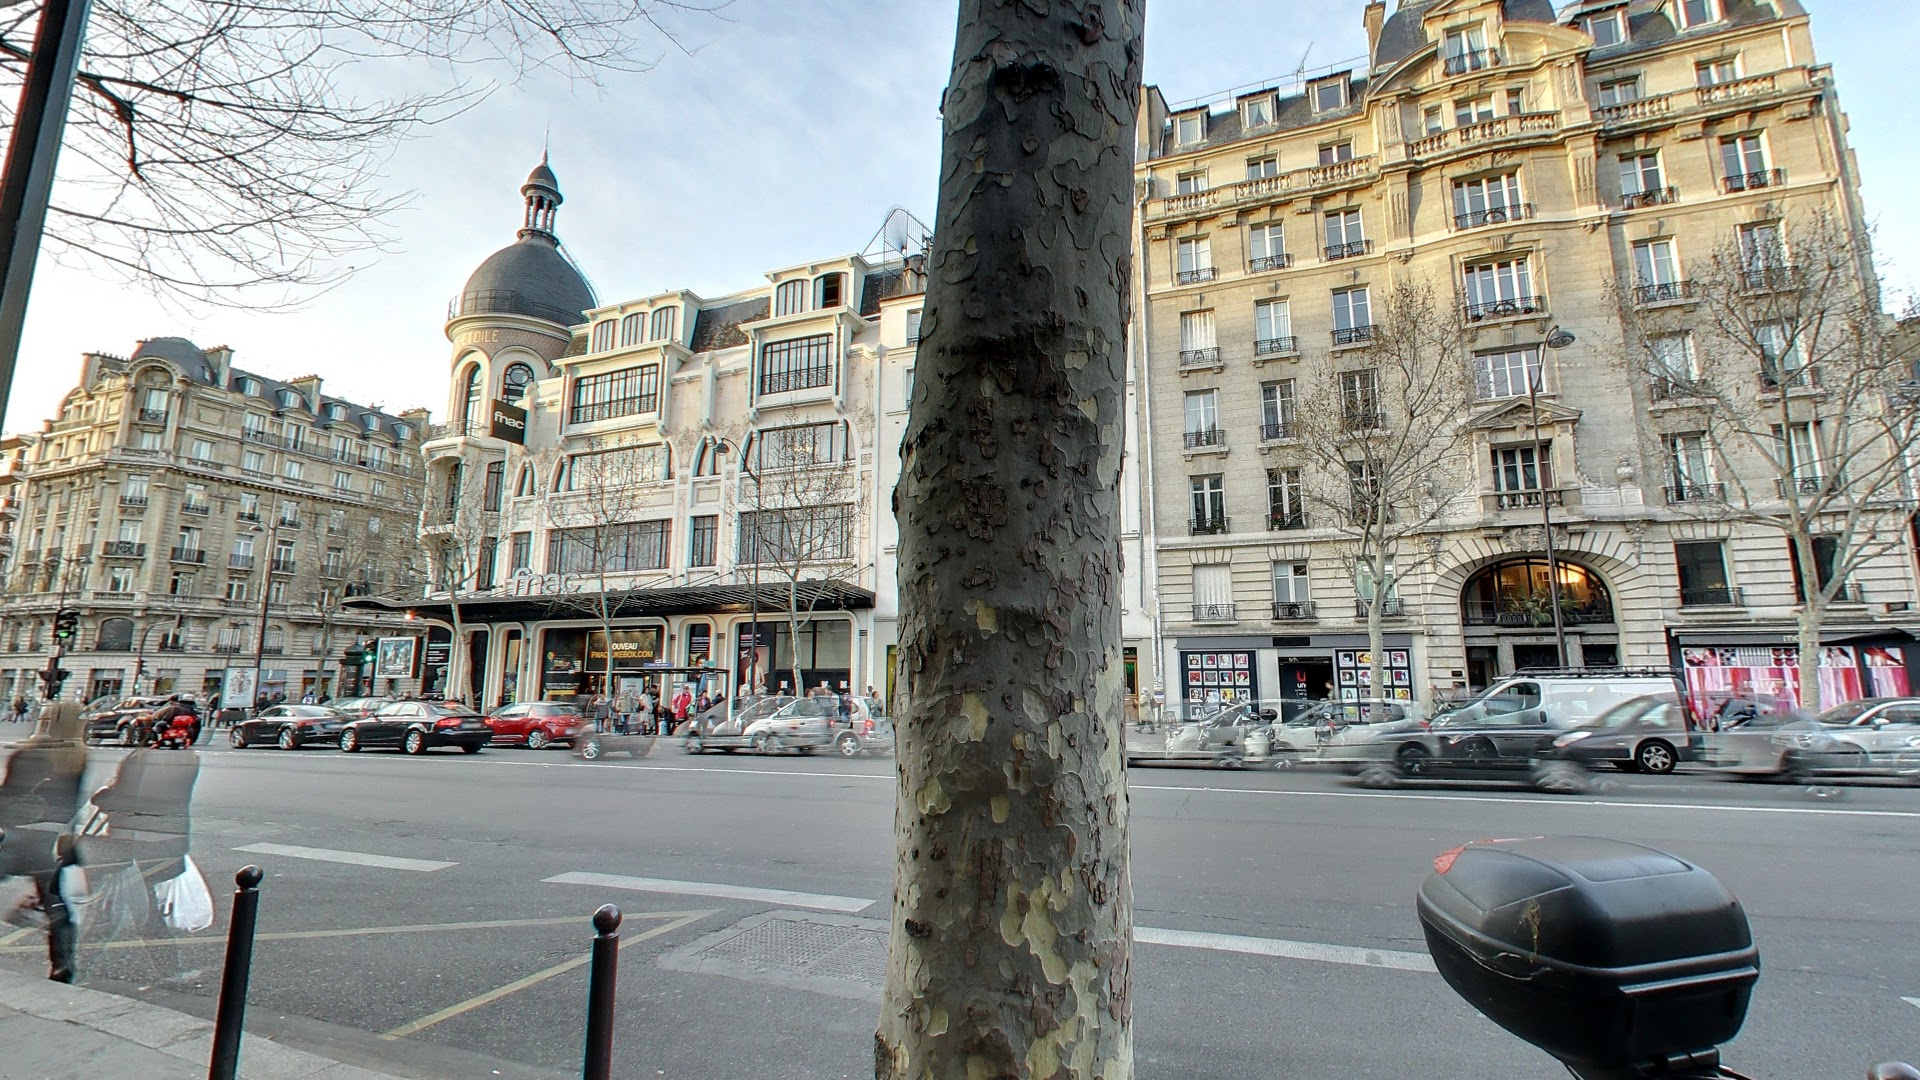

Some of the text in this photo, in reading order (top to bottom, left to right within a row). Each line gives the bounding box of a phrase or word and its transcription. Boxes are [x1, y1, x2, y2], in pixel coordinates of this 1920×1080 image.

[493, 410, 525, 430] fnac
[512, 567, 582, 596] fnac
[611, 642, 638, 650] OUVEAU
